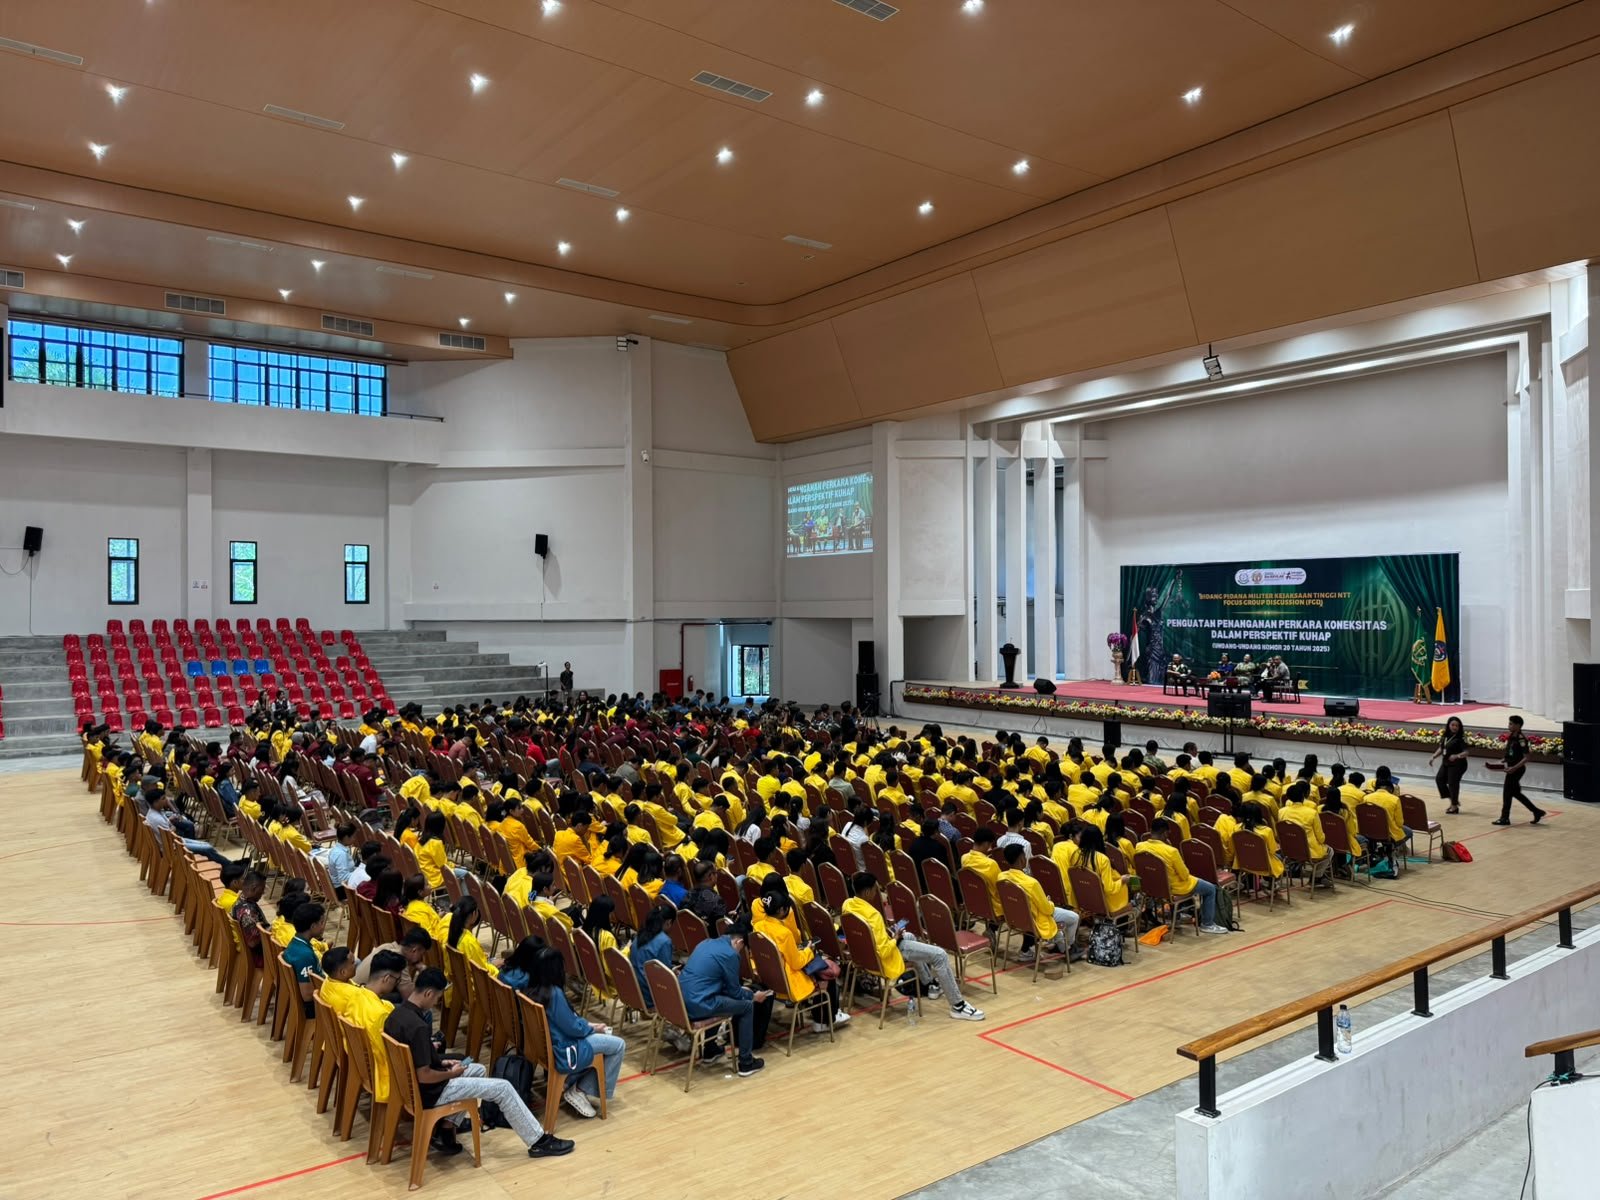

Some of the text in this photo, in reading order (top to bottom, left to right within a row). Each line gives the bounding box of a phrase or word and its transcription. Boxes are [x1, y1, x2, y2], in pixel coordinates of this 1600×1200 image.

[1166, 619, 1387, 630] PENGUATAN PENANGANAN PERKARA KONEKSITAS
[1211, 630, 1331, 641] DALAM PERSPEKTIF KUHAP
